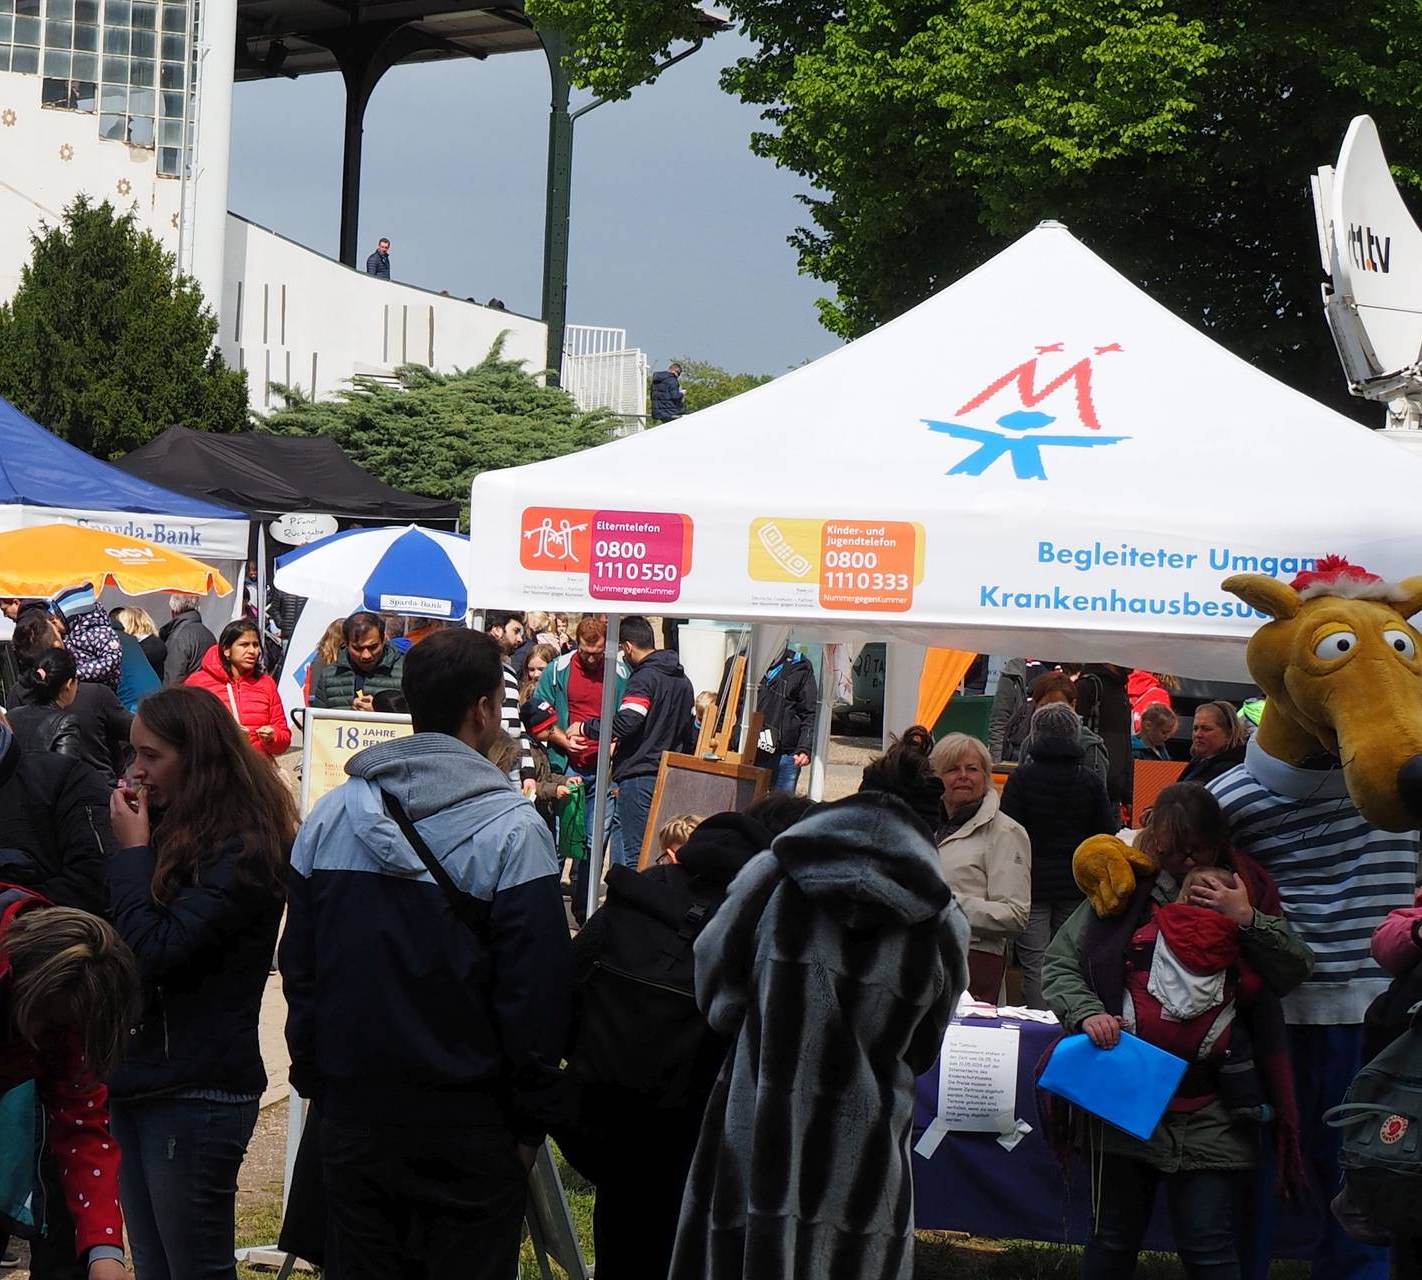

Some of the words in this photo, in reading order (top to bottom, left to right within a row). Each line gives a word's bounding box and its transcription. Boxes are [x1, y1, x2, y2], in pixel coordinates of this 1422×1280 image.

[596, 521, 661, 533] Elterntelefon
[827, 526, 864, 536] Kinder-
[866, 527, 885, 536] und
[826, 536, 897, 548] Jugendtelefon
[595, 541, 646, 559] 0800
[825, 551, 877, 568] 0800
[1038, 541, 1198, 571] Begleiteter
[1209, 548, 1318, 577] Umgan
[593, 584, 675, 596] NummergegenKummer
[389, 599, 442, 609] Sparda-Bank
[823, 594, 907, 605] NummergegenKummer
[335, 726, 359, 750] 18
[363, 728, 396, 738] JAHRE
